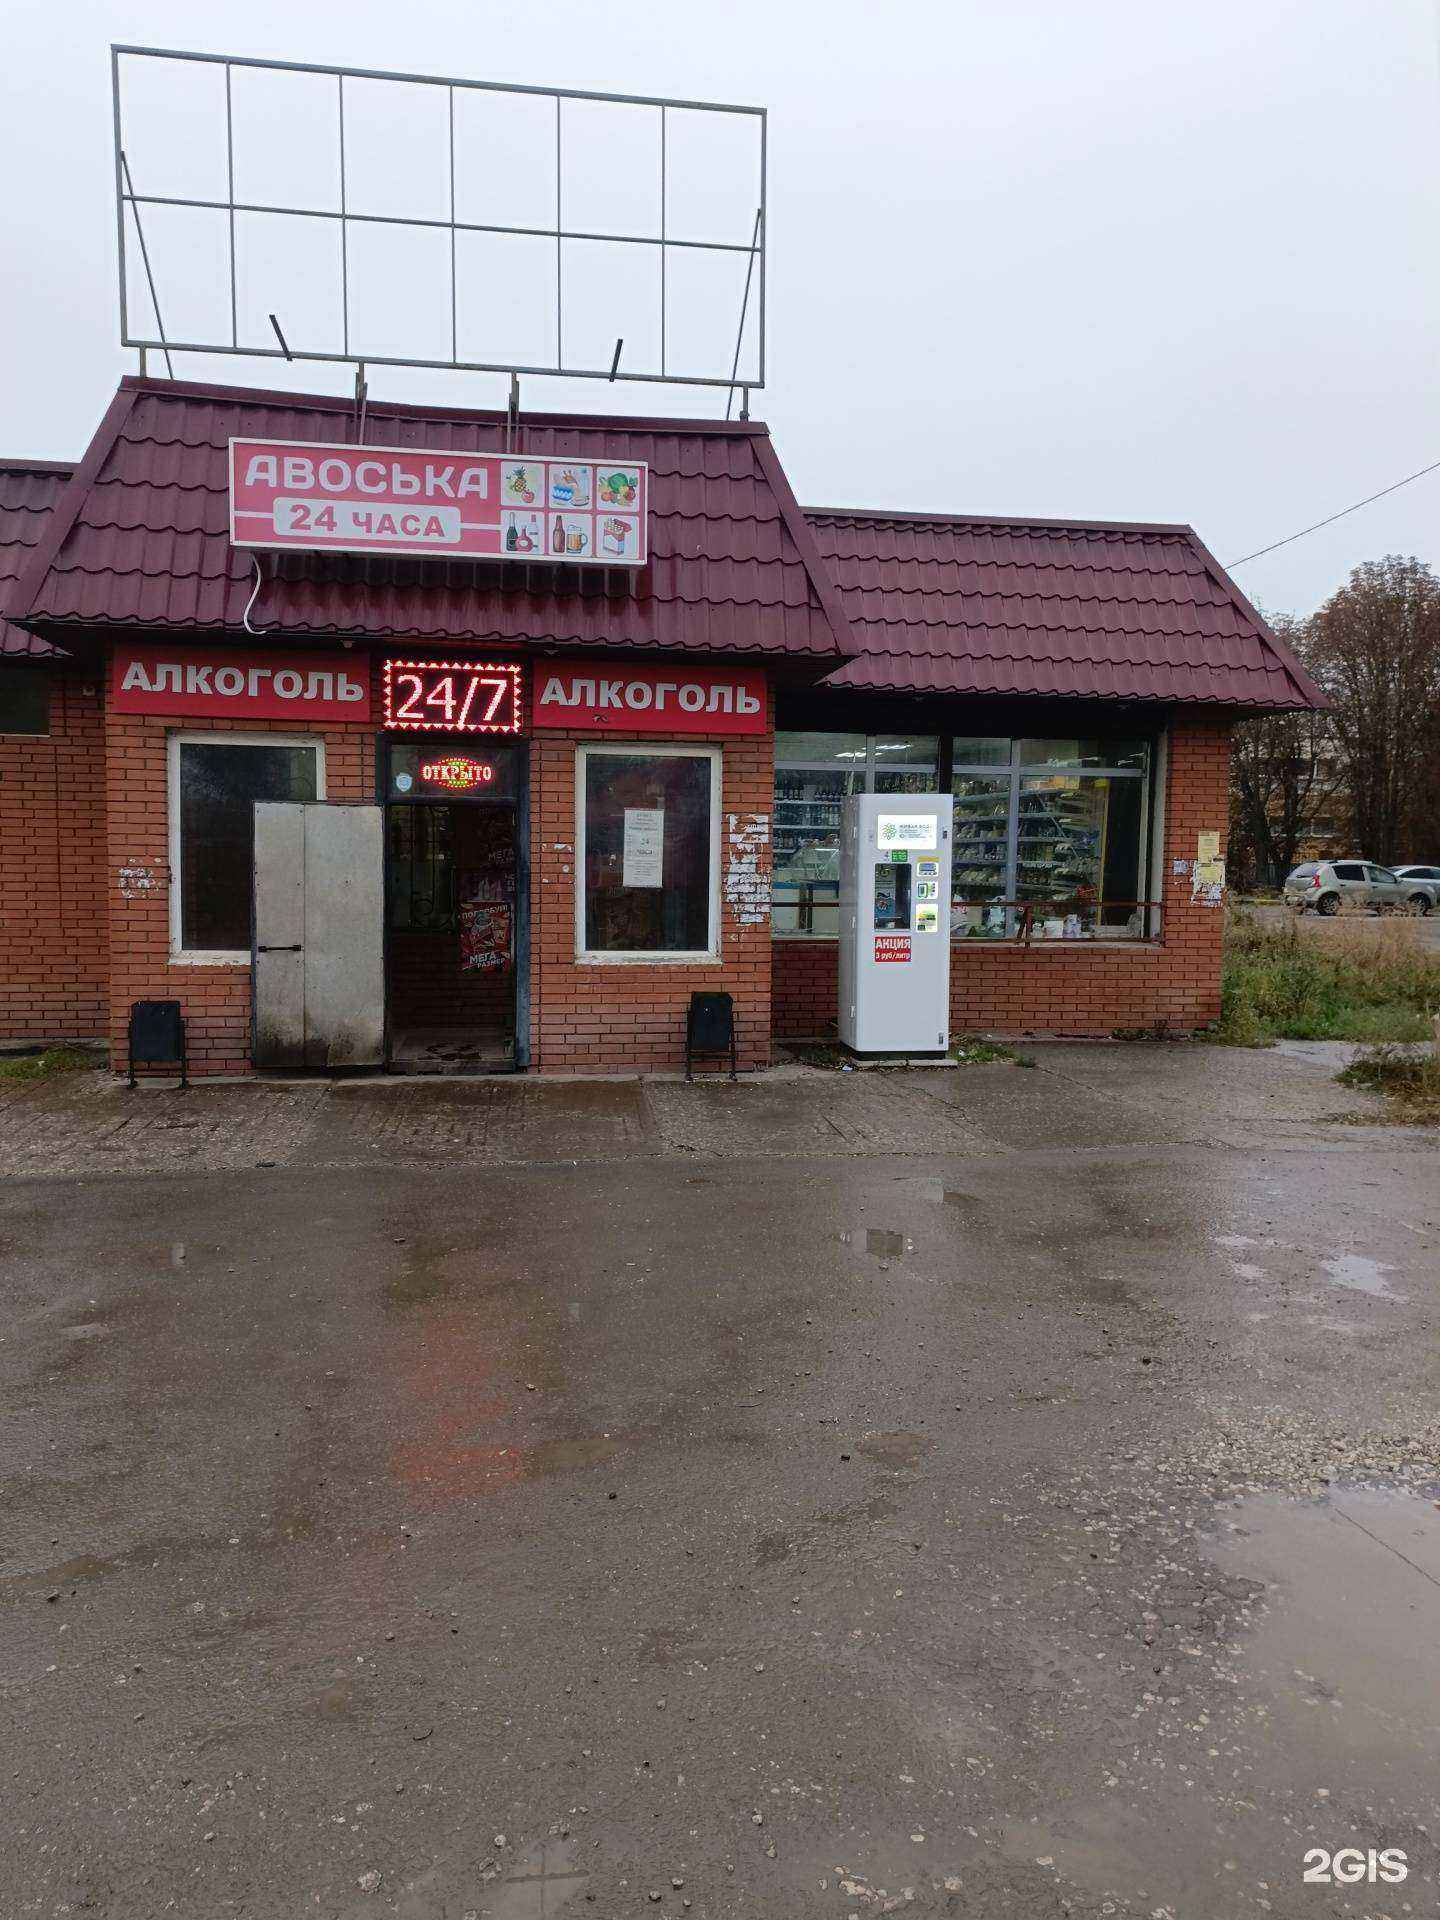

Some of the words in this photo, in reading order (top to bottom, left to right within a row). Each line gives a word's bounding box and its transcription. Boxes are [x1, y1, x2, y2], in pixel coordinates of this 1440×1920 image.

[244, 454, 489, 499] АВОСЬКА
[289, 504, 337, 533] 24
[352, 510, 446, 539] ЧАСА
[121, 660, 365, 703] АЛКОГОЛЬ
[540, 676, 761, 714] АЛКОГОЛЬ
[396, 673, 508, 728] 24/7
[422, 764, 492, 782] ОТКРЫТО
[469, 952, 497, 965] МЕГА
[876, 938, 911, 951] АКЦИЯ
